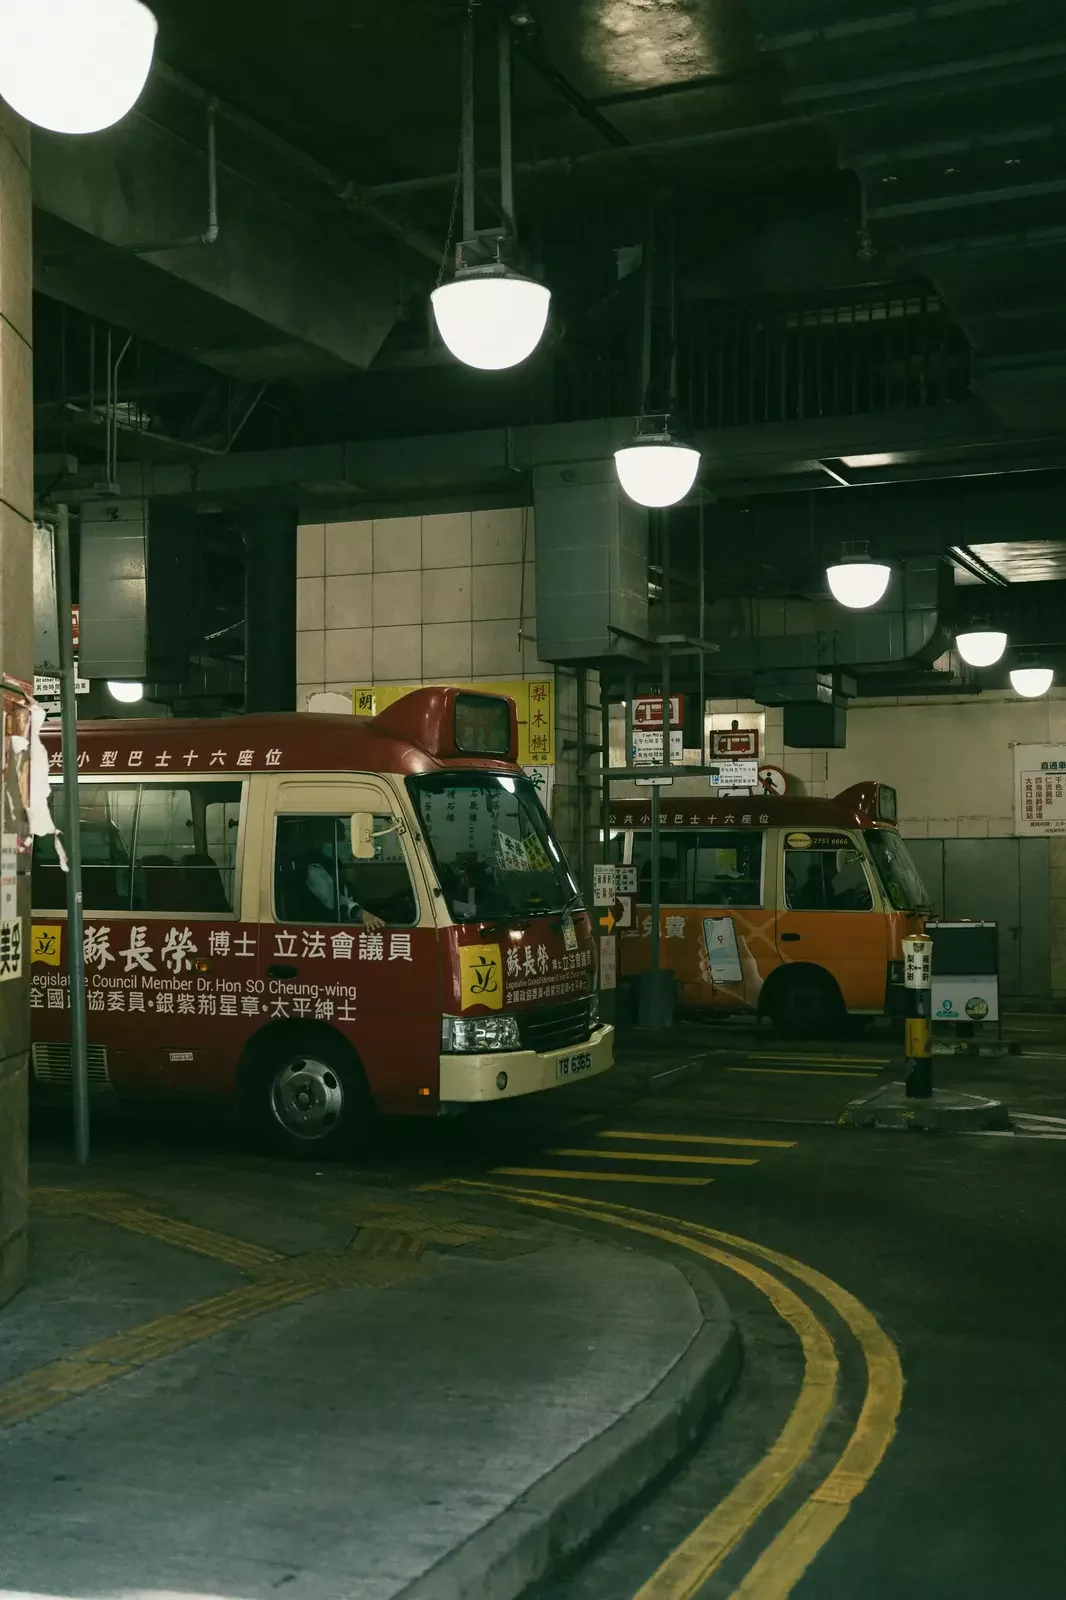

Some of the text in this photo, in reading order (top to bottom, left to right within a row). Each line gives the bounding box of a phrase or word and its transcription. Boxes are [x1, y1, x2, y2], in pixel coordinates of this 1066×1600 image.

[530, 684, 549, 752] 梨木樹
[608, 813, 770, 825] 公共小型巴士十六座位
[83, 925, 413, 975] 蘇長榮 博士 立法會議員
[506, 944, 549, 978] 蘇長榮
[93, 974, 138, 989] Council
[142, 976, 193, 991] Member
[197, 978, 214, 993] Dr.
[216, 979, 242, 993] Hon
[246, 980, 265, 994] SO
[269, 981, 357, 1002] Cheung-wing
